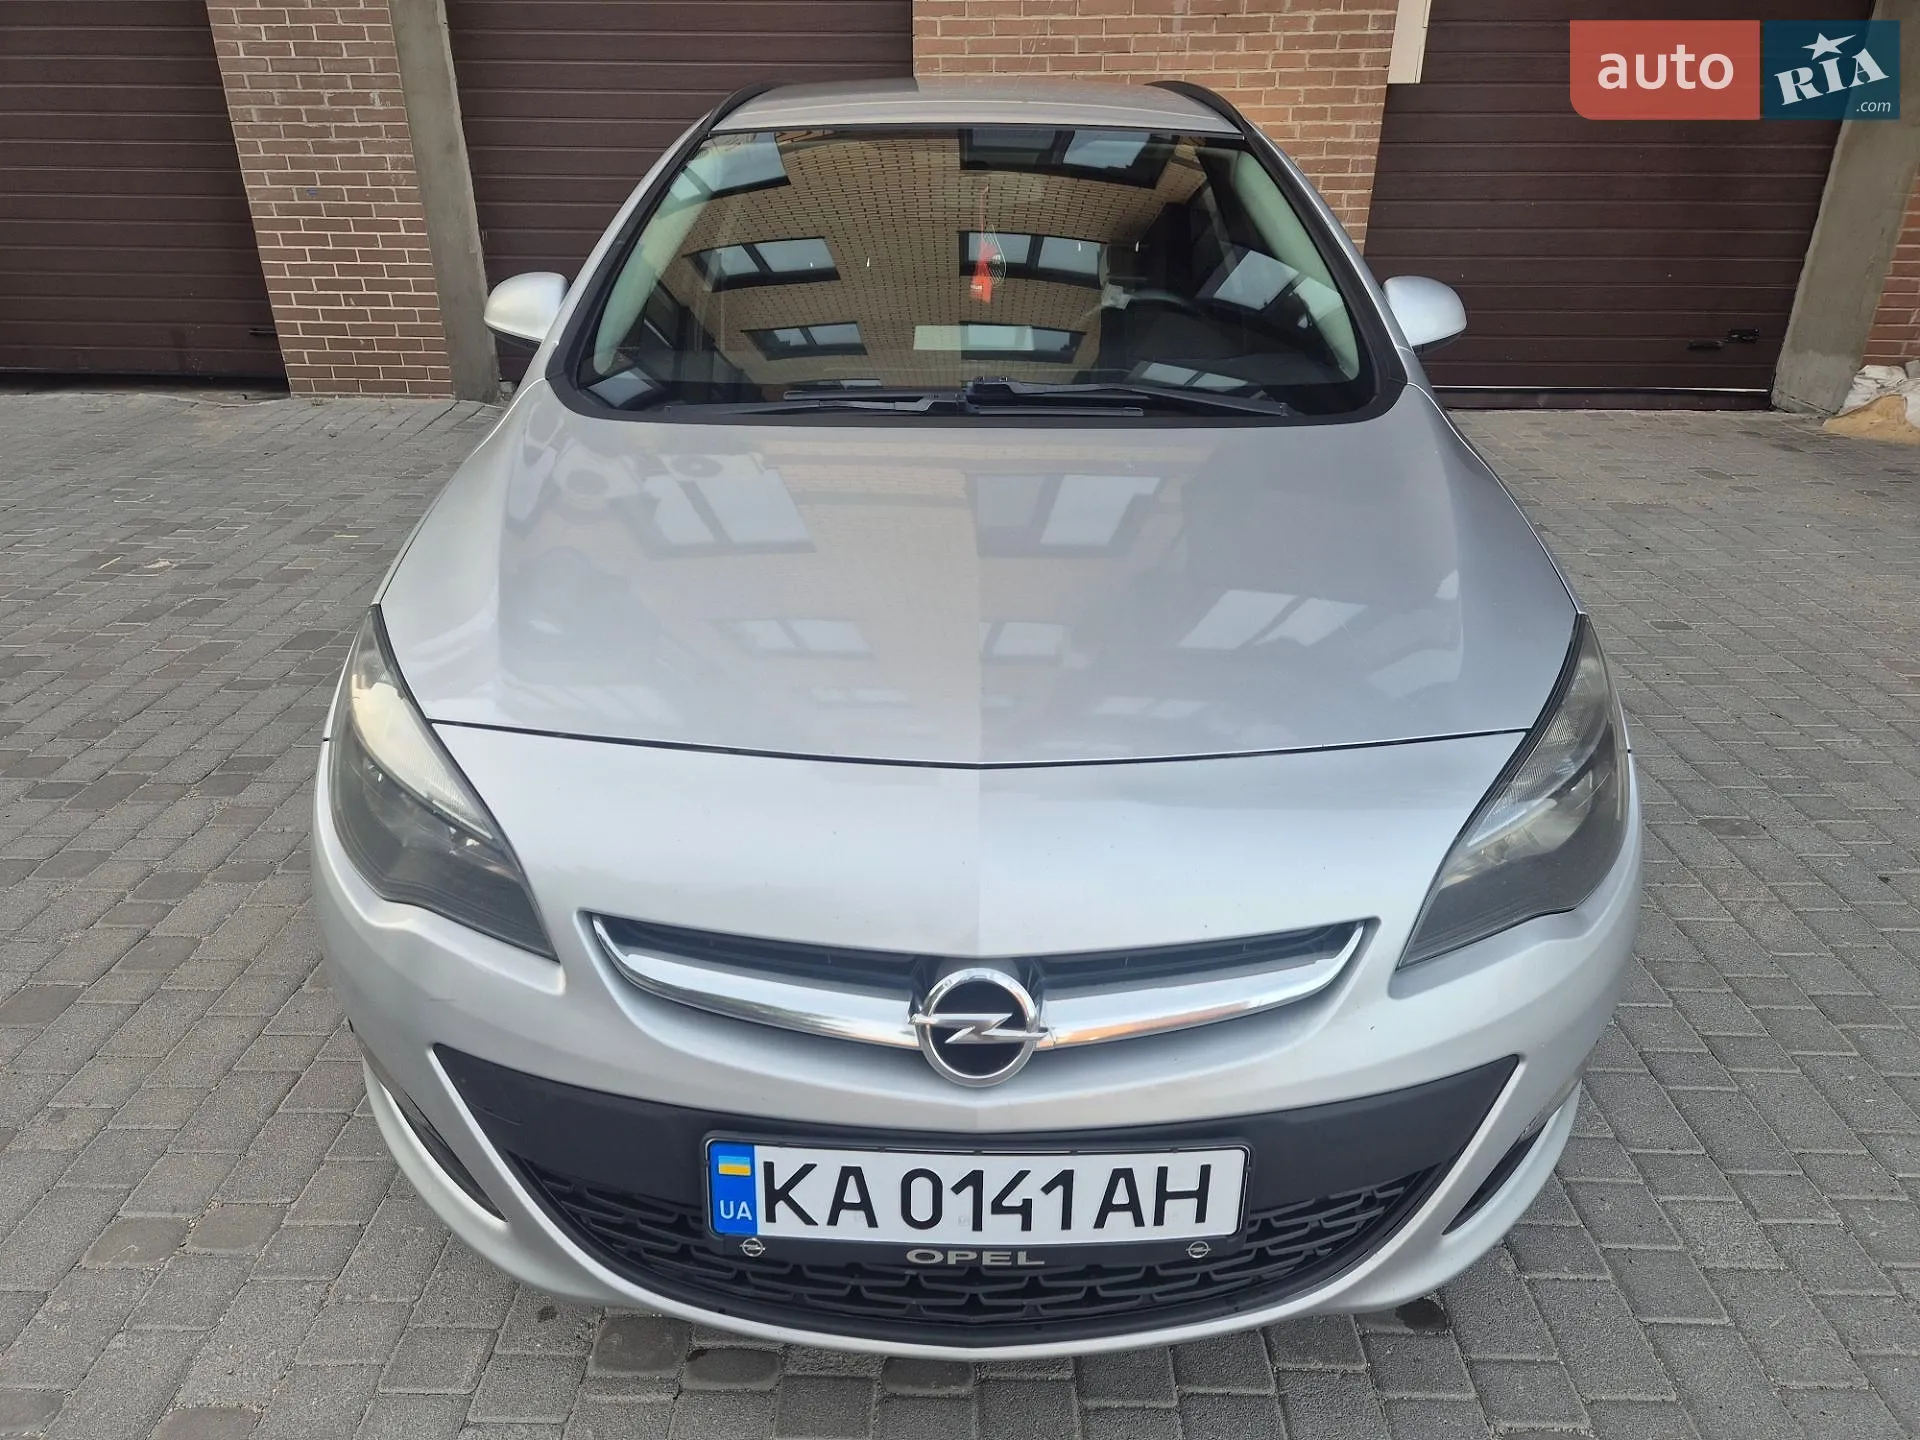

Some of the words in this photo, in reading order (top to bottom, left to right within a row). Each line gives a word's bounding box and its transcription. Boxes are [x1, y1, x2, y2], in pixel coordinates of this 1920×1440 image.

[763, 1161, 879, 1229] KA
[900, 1167, 1074, 1233] 0141
[1093, 1163, 1212, 1229] AH
[719, 1199, 753, 1221] UA
[906, 1248, 1046, 1266] OPEL
